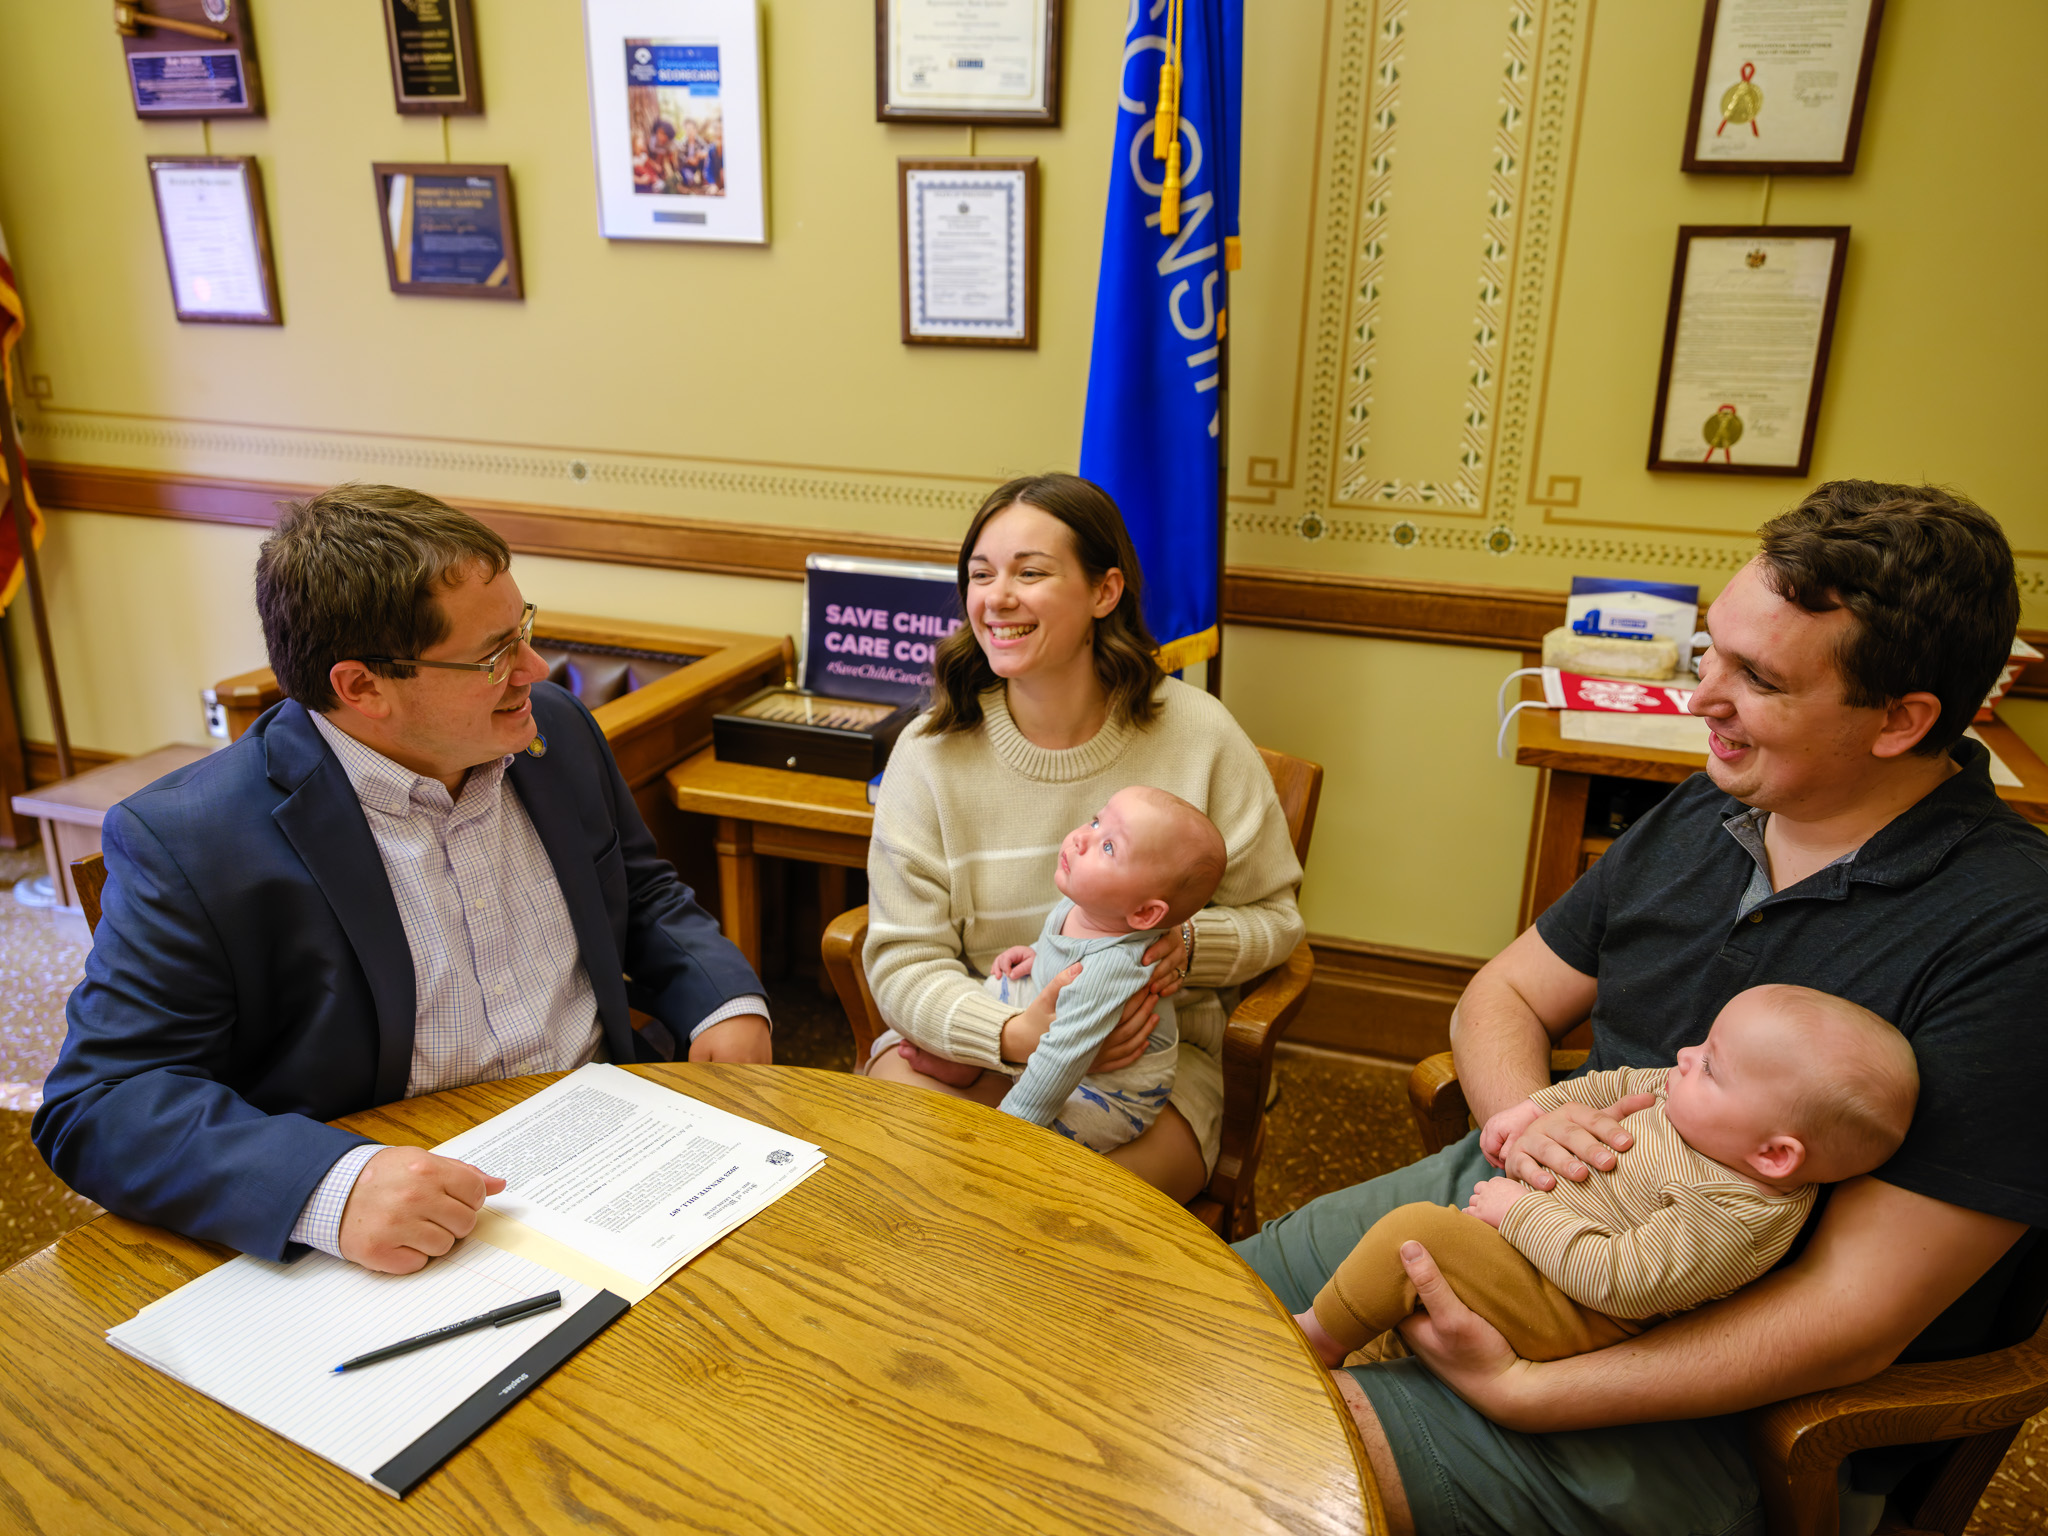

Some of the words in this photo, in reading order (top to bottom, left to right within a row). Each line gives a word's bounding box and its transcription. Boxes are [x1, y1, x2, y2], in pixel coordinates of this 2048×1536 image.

[658, 69, 719, 82] SCORECARD
[825, 603, 889, 631] SAVE
[824, 631, 890, 659] CARE
[721, 1165, 740, 1177] 2023
[696, 1176, 726, 1196] SENATE
[678, 1195, 700, 1208] BILL
[668, 1207, 682, 1216] 487
[501, 1372, 529, 1394] Staples
